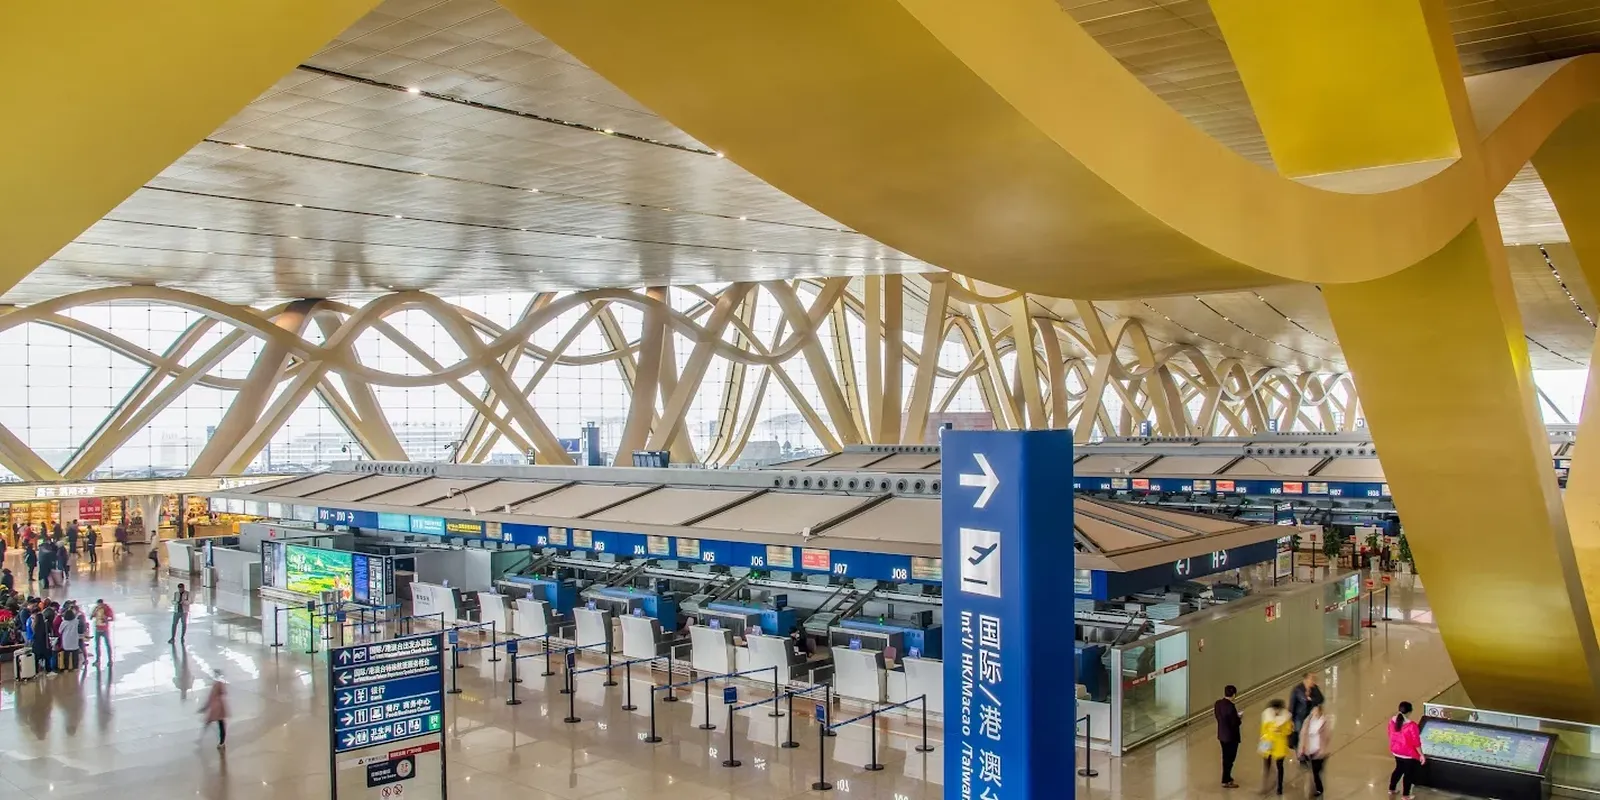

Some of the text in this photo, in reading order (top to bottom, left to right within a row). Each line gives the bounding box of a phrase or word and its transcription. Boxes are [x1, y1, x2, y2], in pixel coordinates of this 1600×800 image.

[1141, 422, 1147, 433] F
[1269, 420, 1275, 429] E
[566, 440, 573, 451] 2
[1329, 488, 1342, 496] H07
[537, 536, 547, 545] J02
[594, 541, 605, 551] J03
[634, 545, 645, 555] J04
[703, 551, 715, 562] J05
[751, 556, 764, 566] J06
[1212, 551, 1219, 569] H
[834, 563, 848, 574] J07
[1185, 557, 1191, 575] J
[892, 568, 907, 579] J08
[370, 686, 386, 695] 银行
[370, 725, 392, 735] 卫生间
